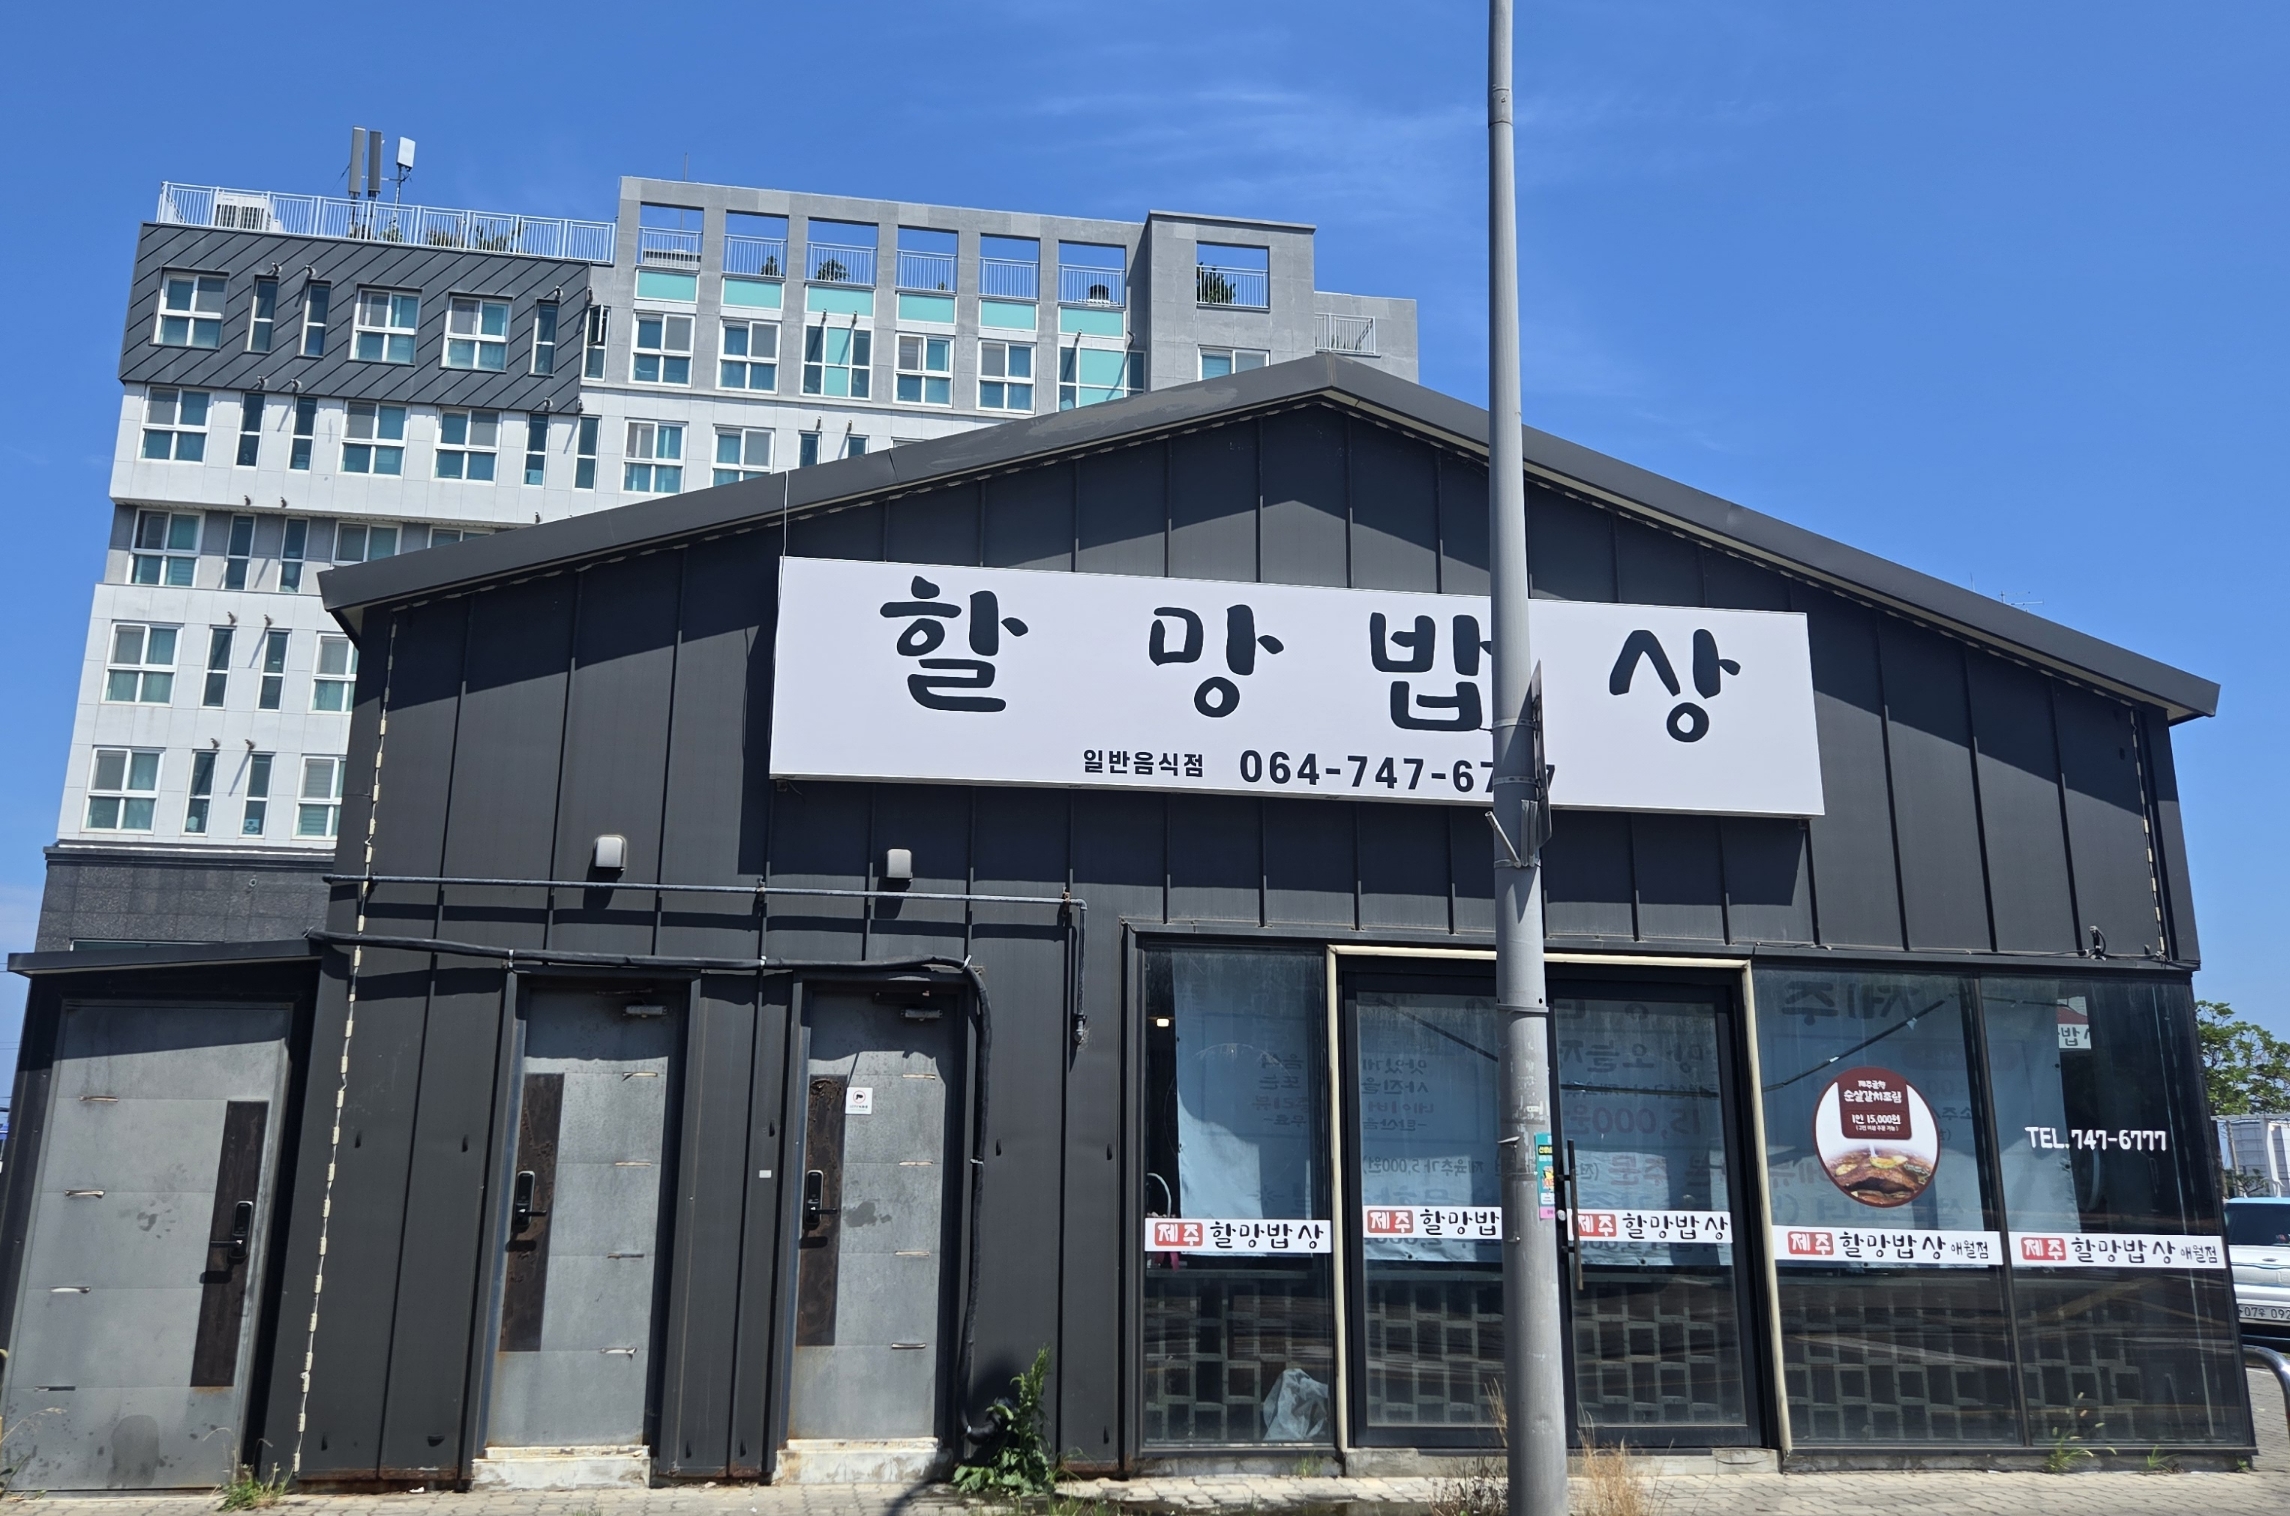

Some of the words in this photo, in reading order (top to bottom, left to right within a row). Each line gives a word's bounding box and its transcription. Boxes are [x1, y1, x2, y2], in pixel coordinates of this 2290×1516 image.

[1083, 749, 1204, 778] 일반음식점
[1240, 749, 1556, 794] 064-747-677
[1866, 1114, 1902, 1125] 15,000원
[1157, 1223, 1200, 1247] 제주
[1209, 1221, 1324, 1250] 할망밥상
[1370, 1211, 1410, 1234] 제주
[1420, 1208, 1500, 1237] 할망밥
[1577, 1215, 1614, 1237] 제주
[1622, 1212, 1729, 1241] 할망밥상
[1790, 1233, 1831, 1256] 제주
[1838, 1231, 1947, 1260] 할망밥상
[1951, 1240, 1989, 1260] 애월점
[2023, 1238, 2064, 1261] 제주
[2071, 1236, 2176, 1264] 할망밥상
[2180, 1244, 2219, 1264] 애월점
